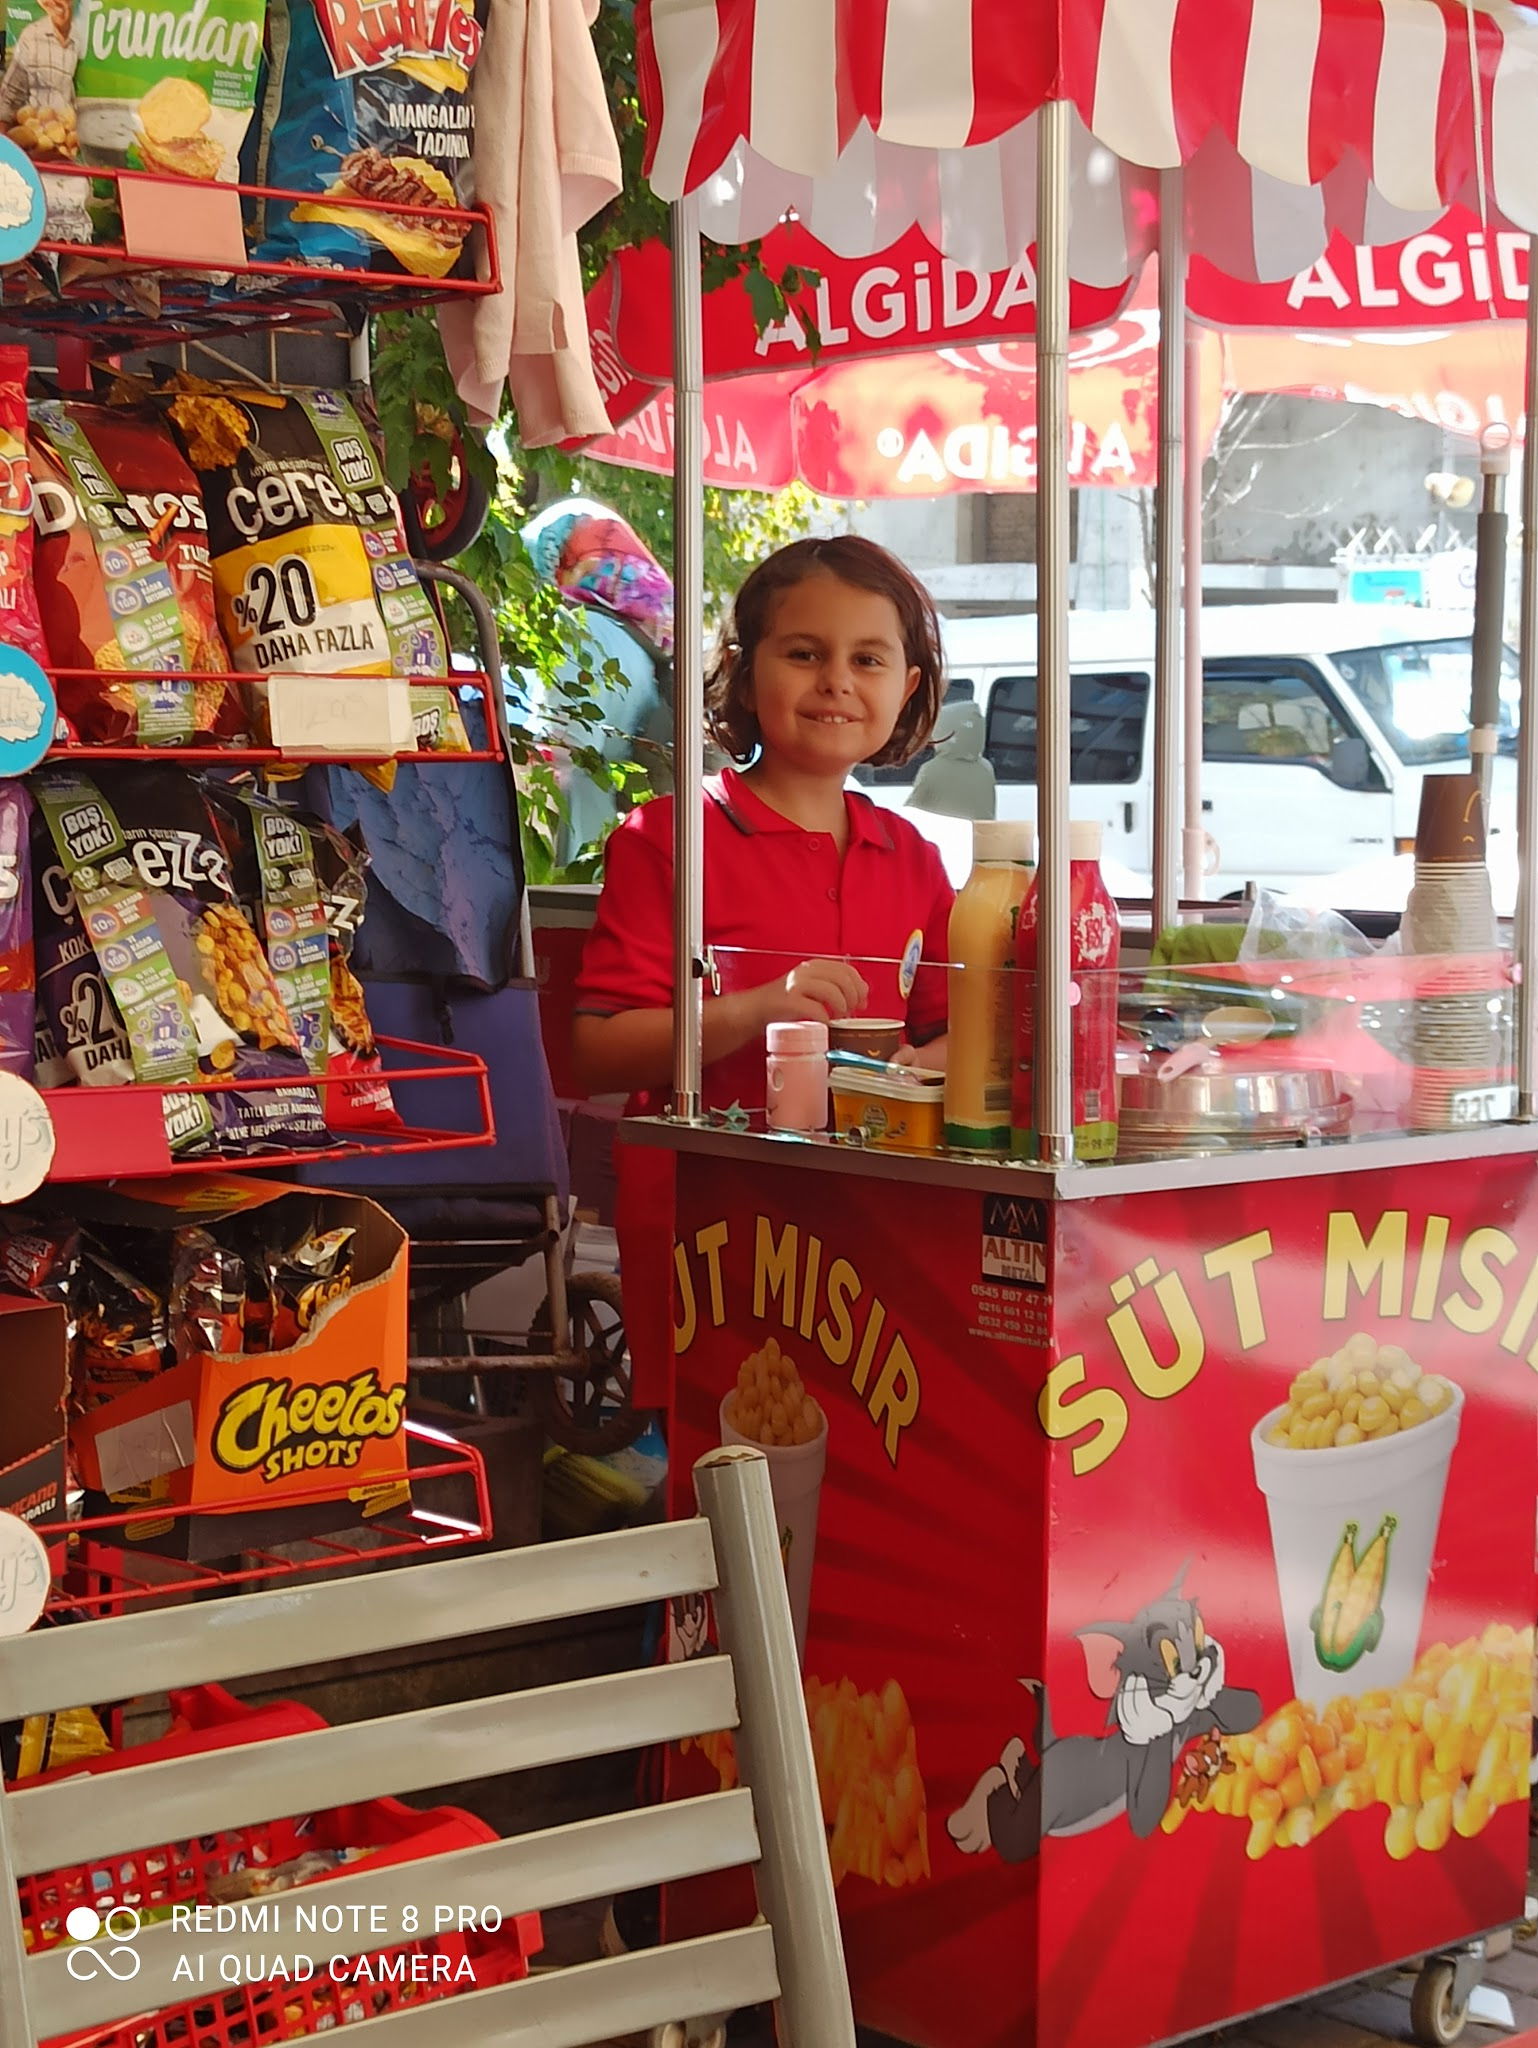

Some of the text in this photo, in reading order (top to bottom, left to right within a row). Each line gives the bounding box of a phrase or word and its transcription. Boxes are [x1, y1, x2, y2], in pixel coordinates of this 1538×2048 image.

[232, 559, 315, 635] %20
[254, 624, 374, 669] DAHA FAZLA
[64, 806, 101, 835] BOŞ
[266, 816, 295, 836] BOŞ
[69, 826, 113, 858] YOK!
[265, 834, 302, 858] YOK!
[984, 1236, 1046, 1268] ALTIN
[753, 1215, 919, 1466] MISIR
[1038, 1211, 1538, 1476] SÜT MISI
[216, 1373, 406, 1468] Cheetos
[265, 1440, 362, 1480] SHOTS
